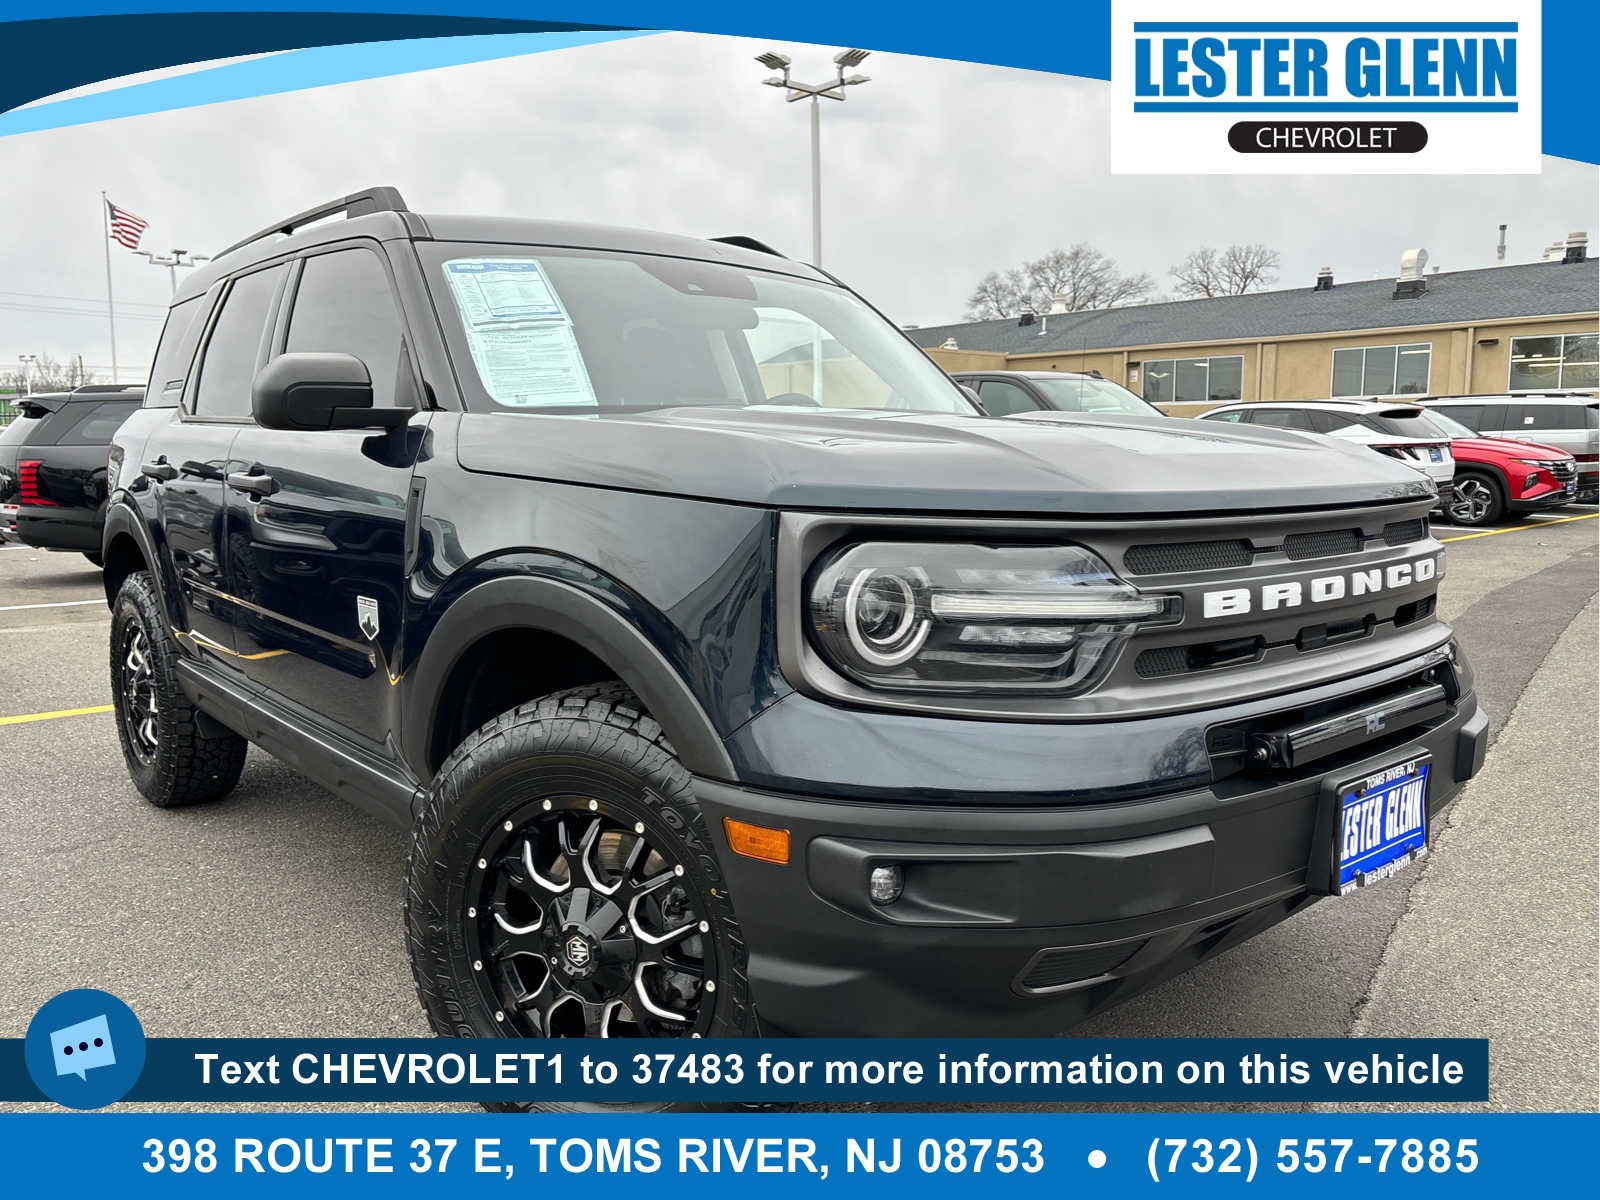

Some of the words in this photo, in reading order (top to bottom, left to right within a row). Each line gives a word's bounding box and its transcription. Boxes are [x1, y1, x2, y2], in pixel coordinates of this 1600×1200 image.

[1203, 557, 1436, 619] BRONCO
[1366, 773, 1386, 790] TOMS
[1406, 761, 1416, 775] NJ
[641, 785, 722, 881] TOYO
[1385, 779, 1423, 841] GLENN
